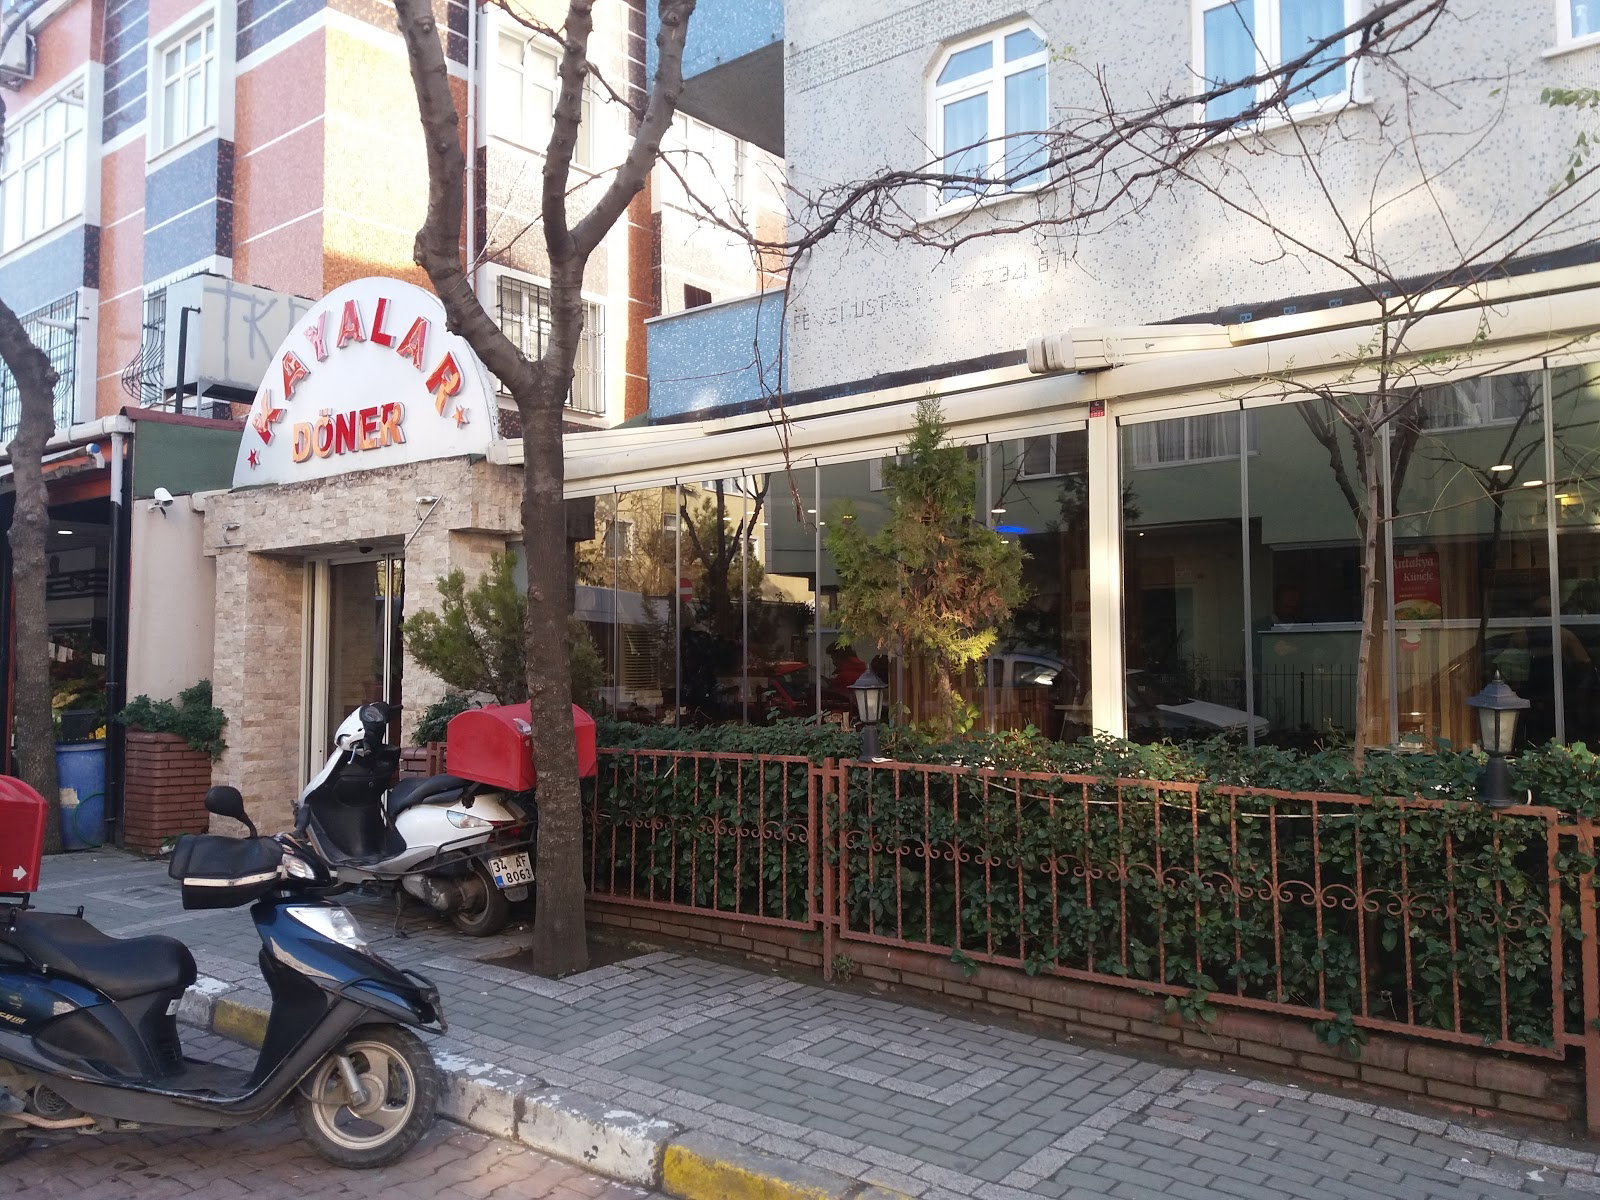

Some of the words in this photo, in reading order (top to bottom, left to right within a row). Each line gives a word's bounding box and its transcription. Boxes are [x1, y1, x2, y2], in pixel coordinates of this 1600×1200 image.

[252, 297, 465, 445] KAYALAR
[292, 401, 406, 463] DÖNER
[493, 858, 507, 872] 34
[506, 868, 531, 883] 8063
